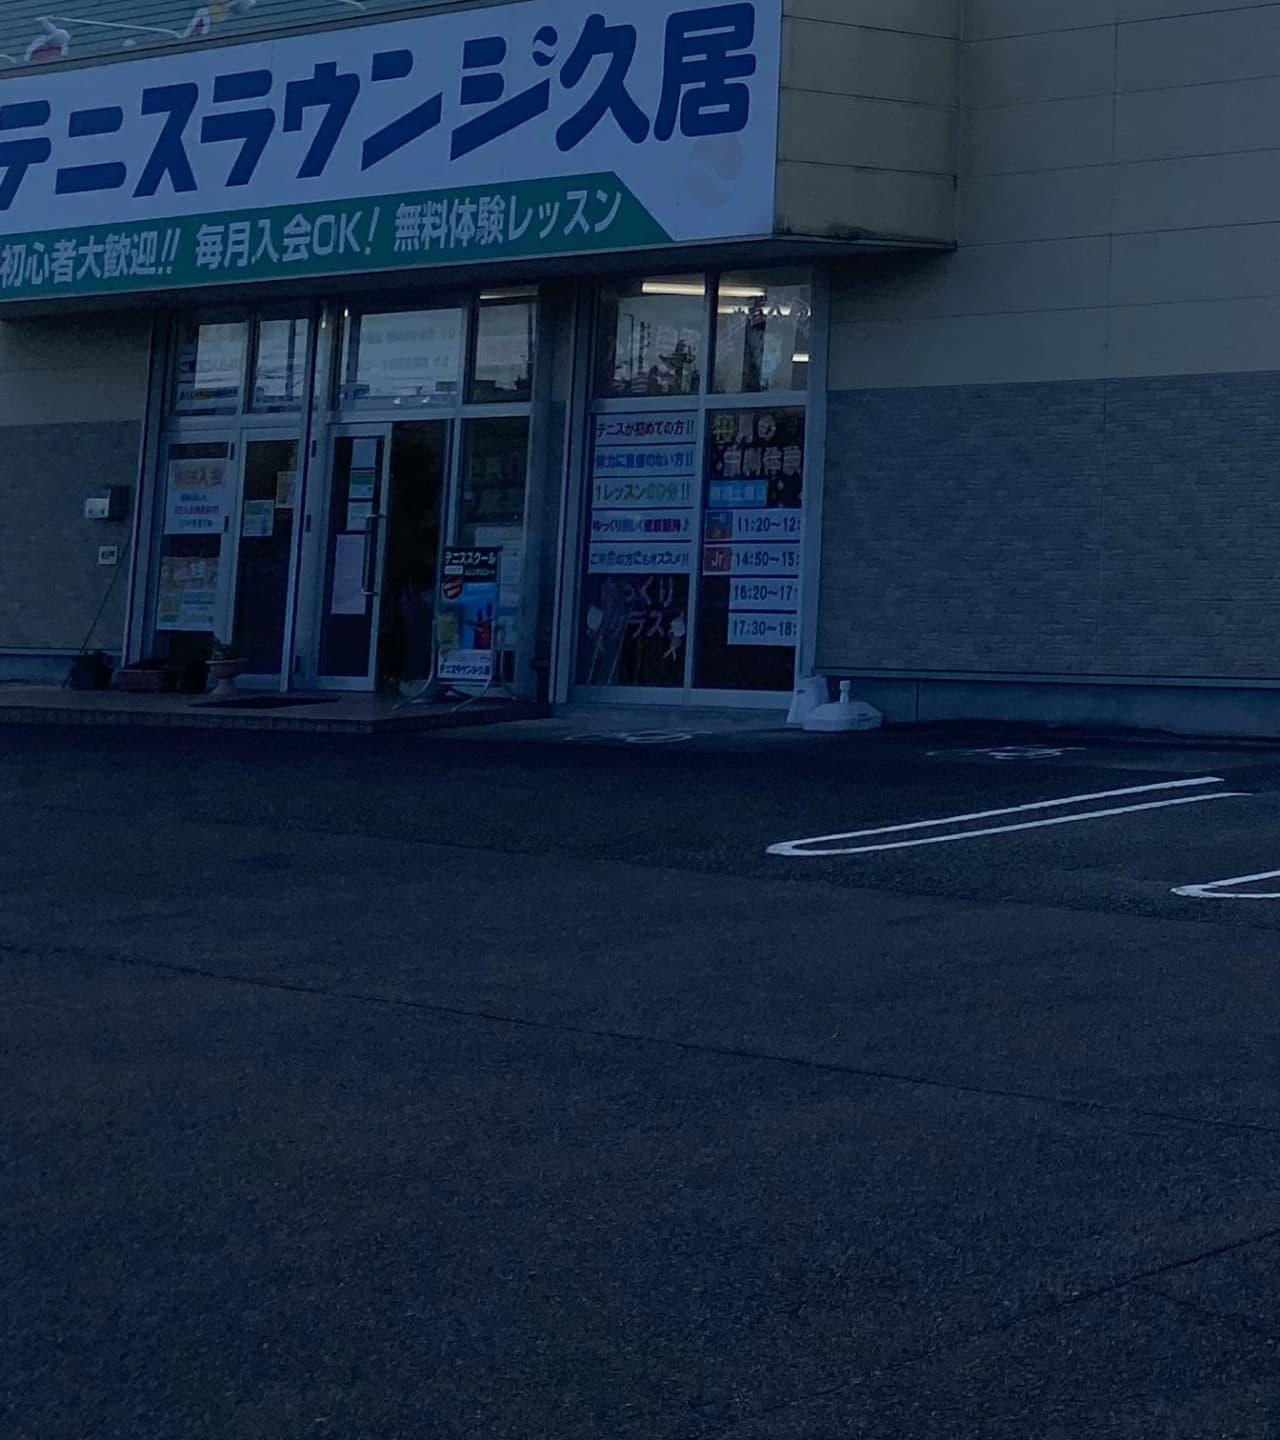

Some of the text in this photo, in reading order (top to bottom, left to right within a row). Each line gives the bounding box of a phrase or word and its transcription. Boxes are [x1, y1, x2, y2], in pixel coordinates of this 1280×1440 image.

[0, 3, 758, 211] テニスラウンジ久居
[0, 188, 623, 291] 初心者大歓迎!! 毎月入会OK! 無料体験レッスン
[711, 551, 724, 568] Jr
